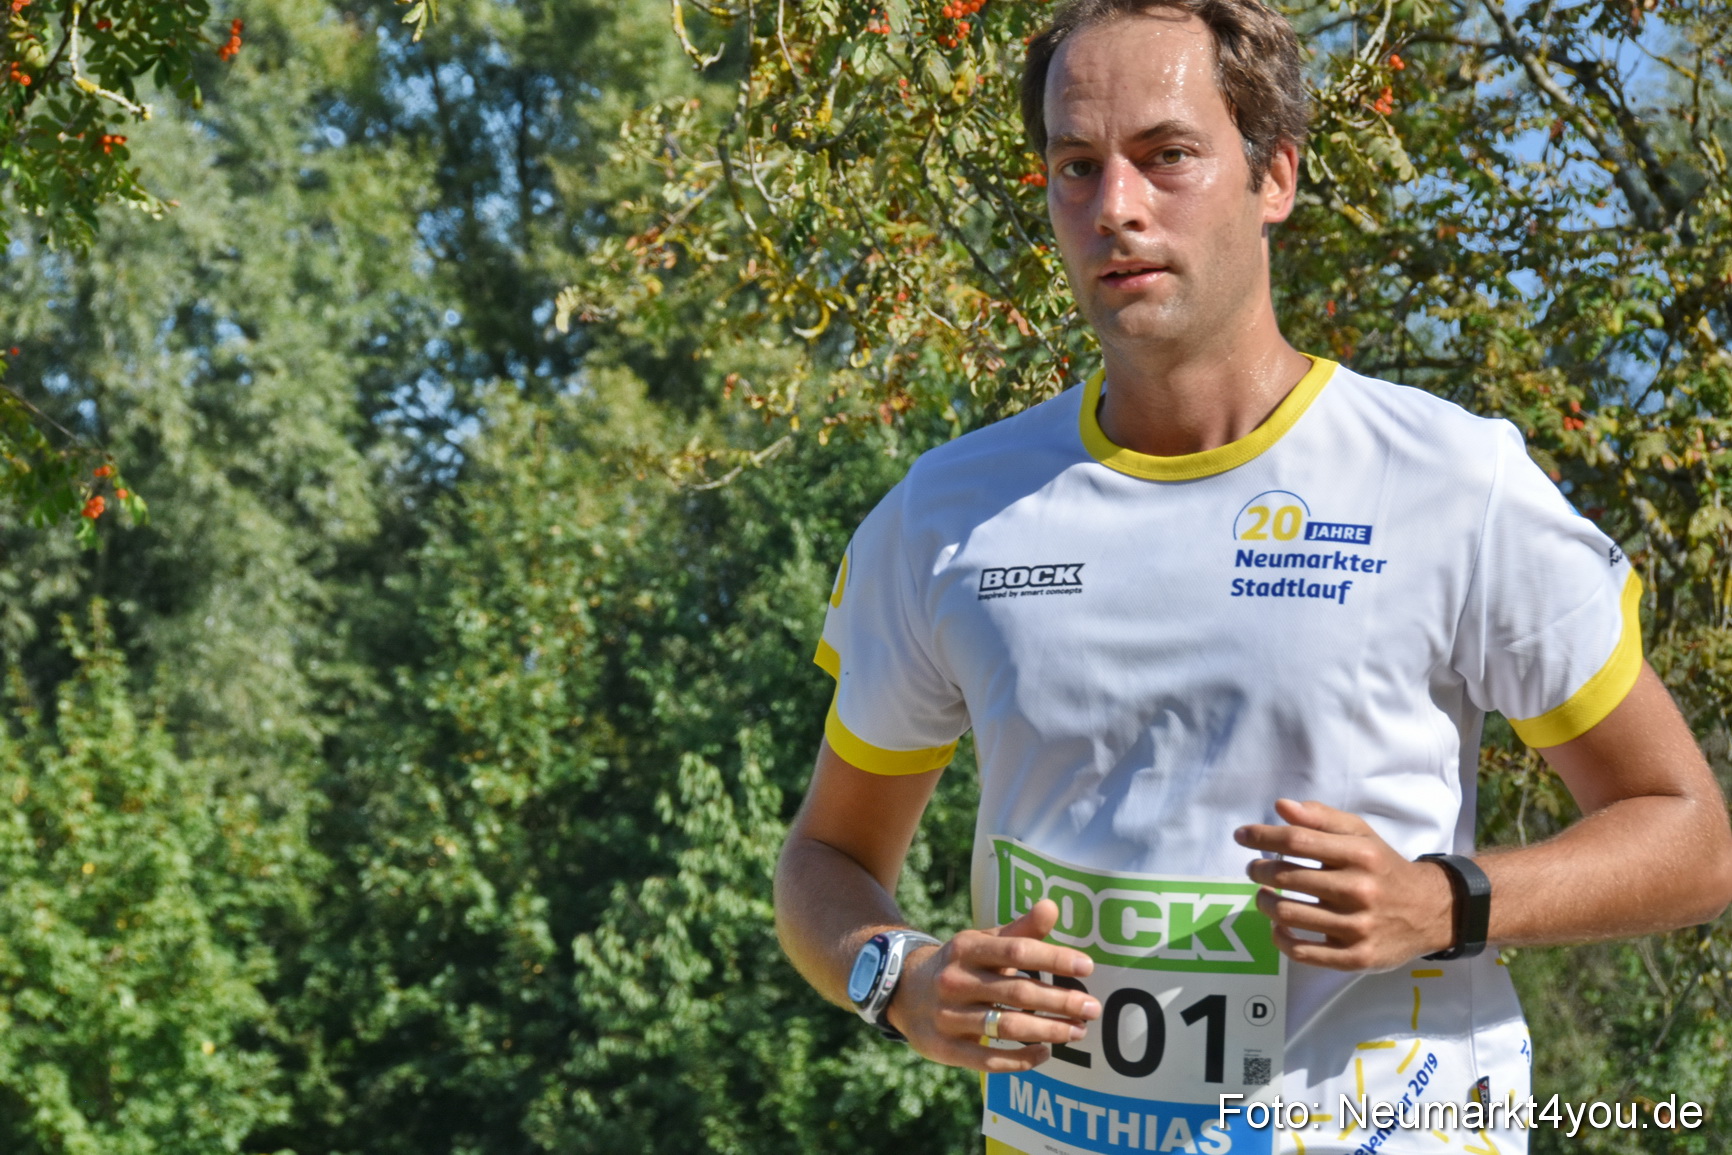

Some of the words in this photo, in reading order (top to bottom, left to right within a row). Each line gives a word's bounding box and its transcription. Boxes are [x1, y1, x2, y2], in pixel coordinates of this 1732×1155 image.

[1240, 505, 1303, 541] 20
[1309, 525, 1367, 541] JAHRE
[1235, 549, 1387, 574] Neumarkter
[979, 563, 1085, 592] BOCK
[1231, 577, 1353, 605] Stadtlauf
[1009, 590, 1018, 598] by
[1020, 589, 1043, 597] smart
[1046, 588, 1082, 596] concepts
[1010, 857, 1254, 962] BOCK
[1252, 1003, 1267, 1018] D
[1408, 1052, 1438, 1097] 2019
[1009, 1074, 1232, 1155] MATTHIAS
